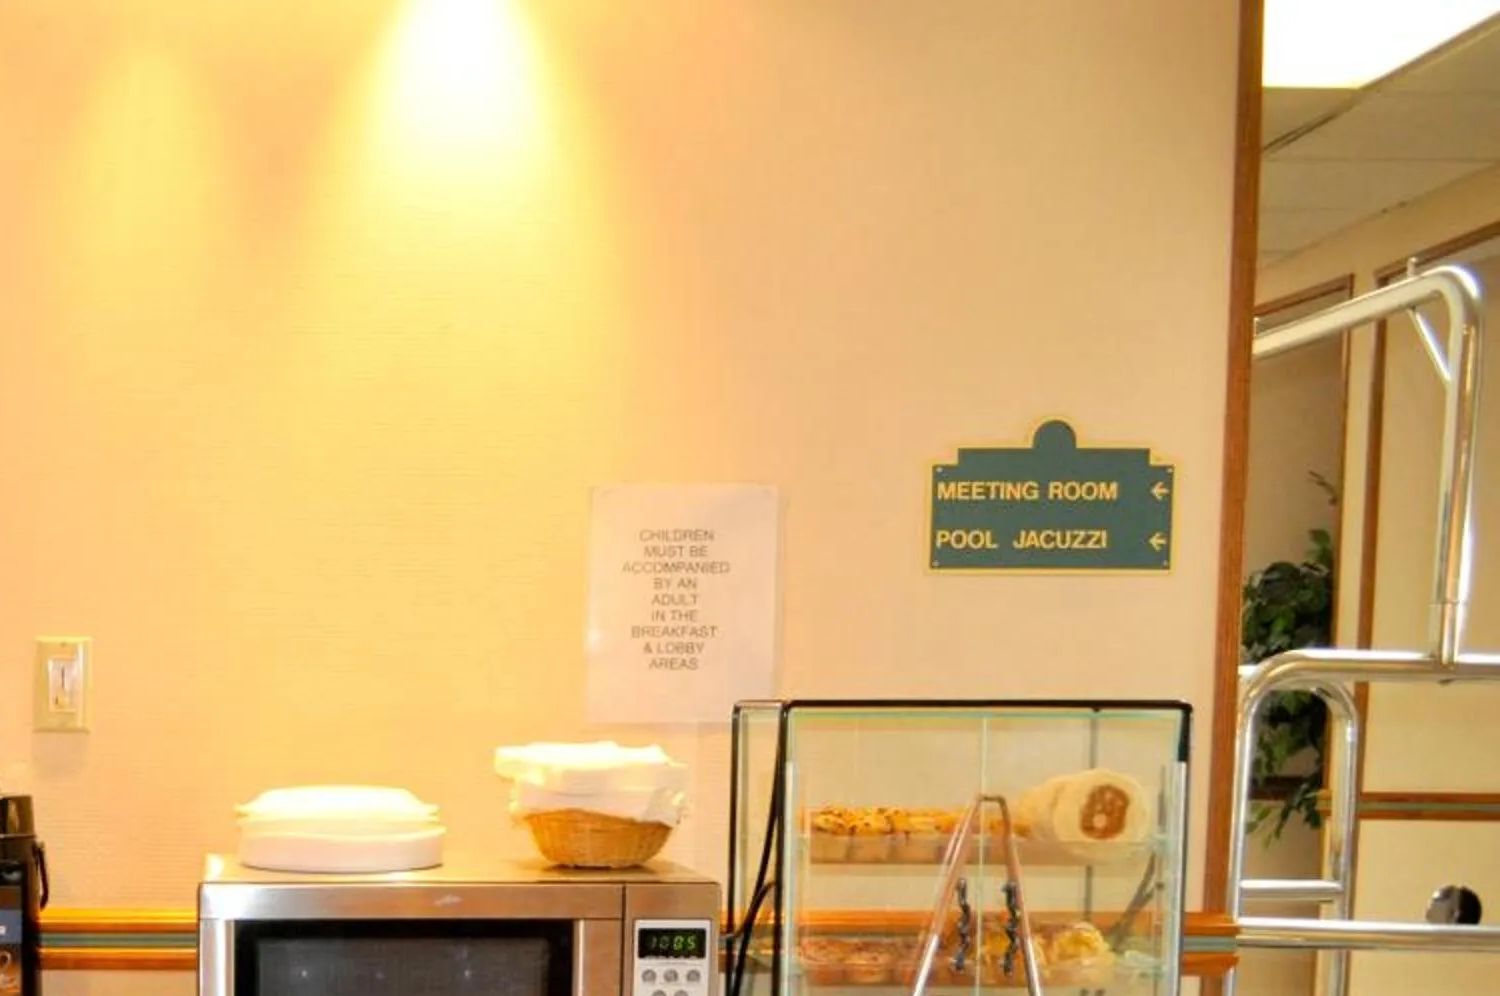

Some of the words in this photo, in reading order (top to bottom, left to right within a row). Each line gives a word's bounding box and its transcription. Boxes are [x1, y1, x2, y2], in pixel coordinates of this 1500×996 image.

[937, 481, 1040, 501] MEETING
[1048, 481, 1118, 501] ROOM
[639, 529, 715, 542] CHILDREN
[935, 530, 998, 549] POOL
[1012, 530, 1108, 549] JACUZZI
[644, 545, 684, 558] MUST
[689, 545, 709, 558] BE
[622, 561, 731, 574] ACCOMPANIED
[653, 577, 671, 590] BY
[677, 577, 698, 590] AN
[651, 594, 699, 606] ADULT
[651, 610, 666, 622] IN
[670, 610, 699, 622] THE
[631, 626, 718, 639] BREAKFAST
[643, 642, 653, 654] &
[657, 642, 705, 654] LOBBY
[648, 658, 699, 671] AREAS
